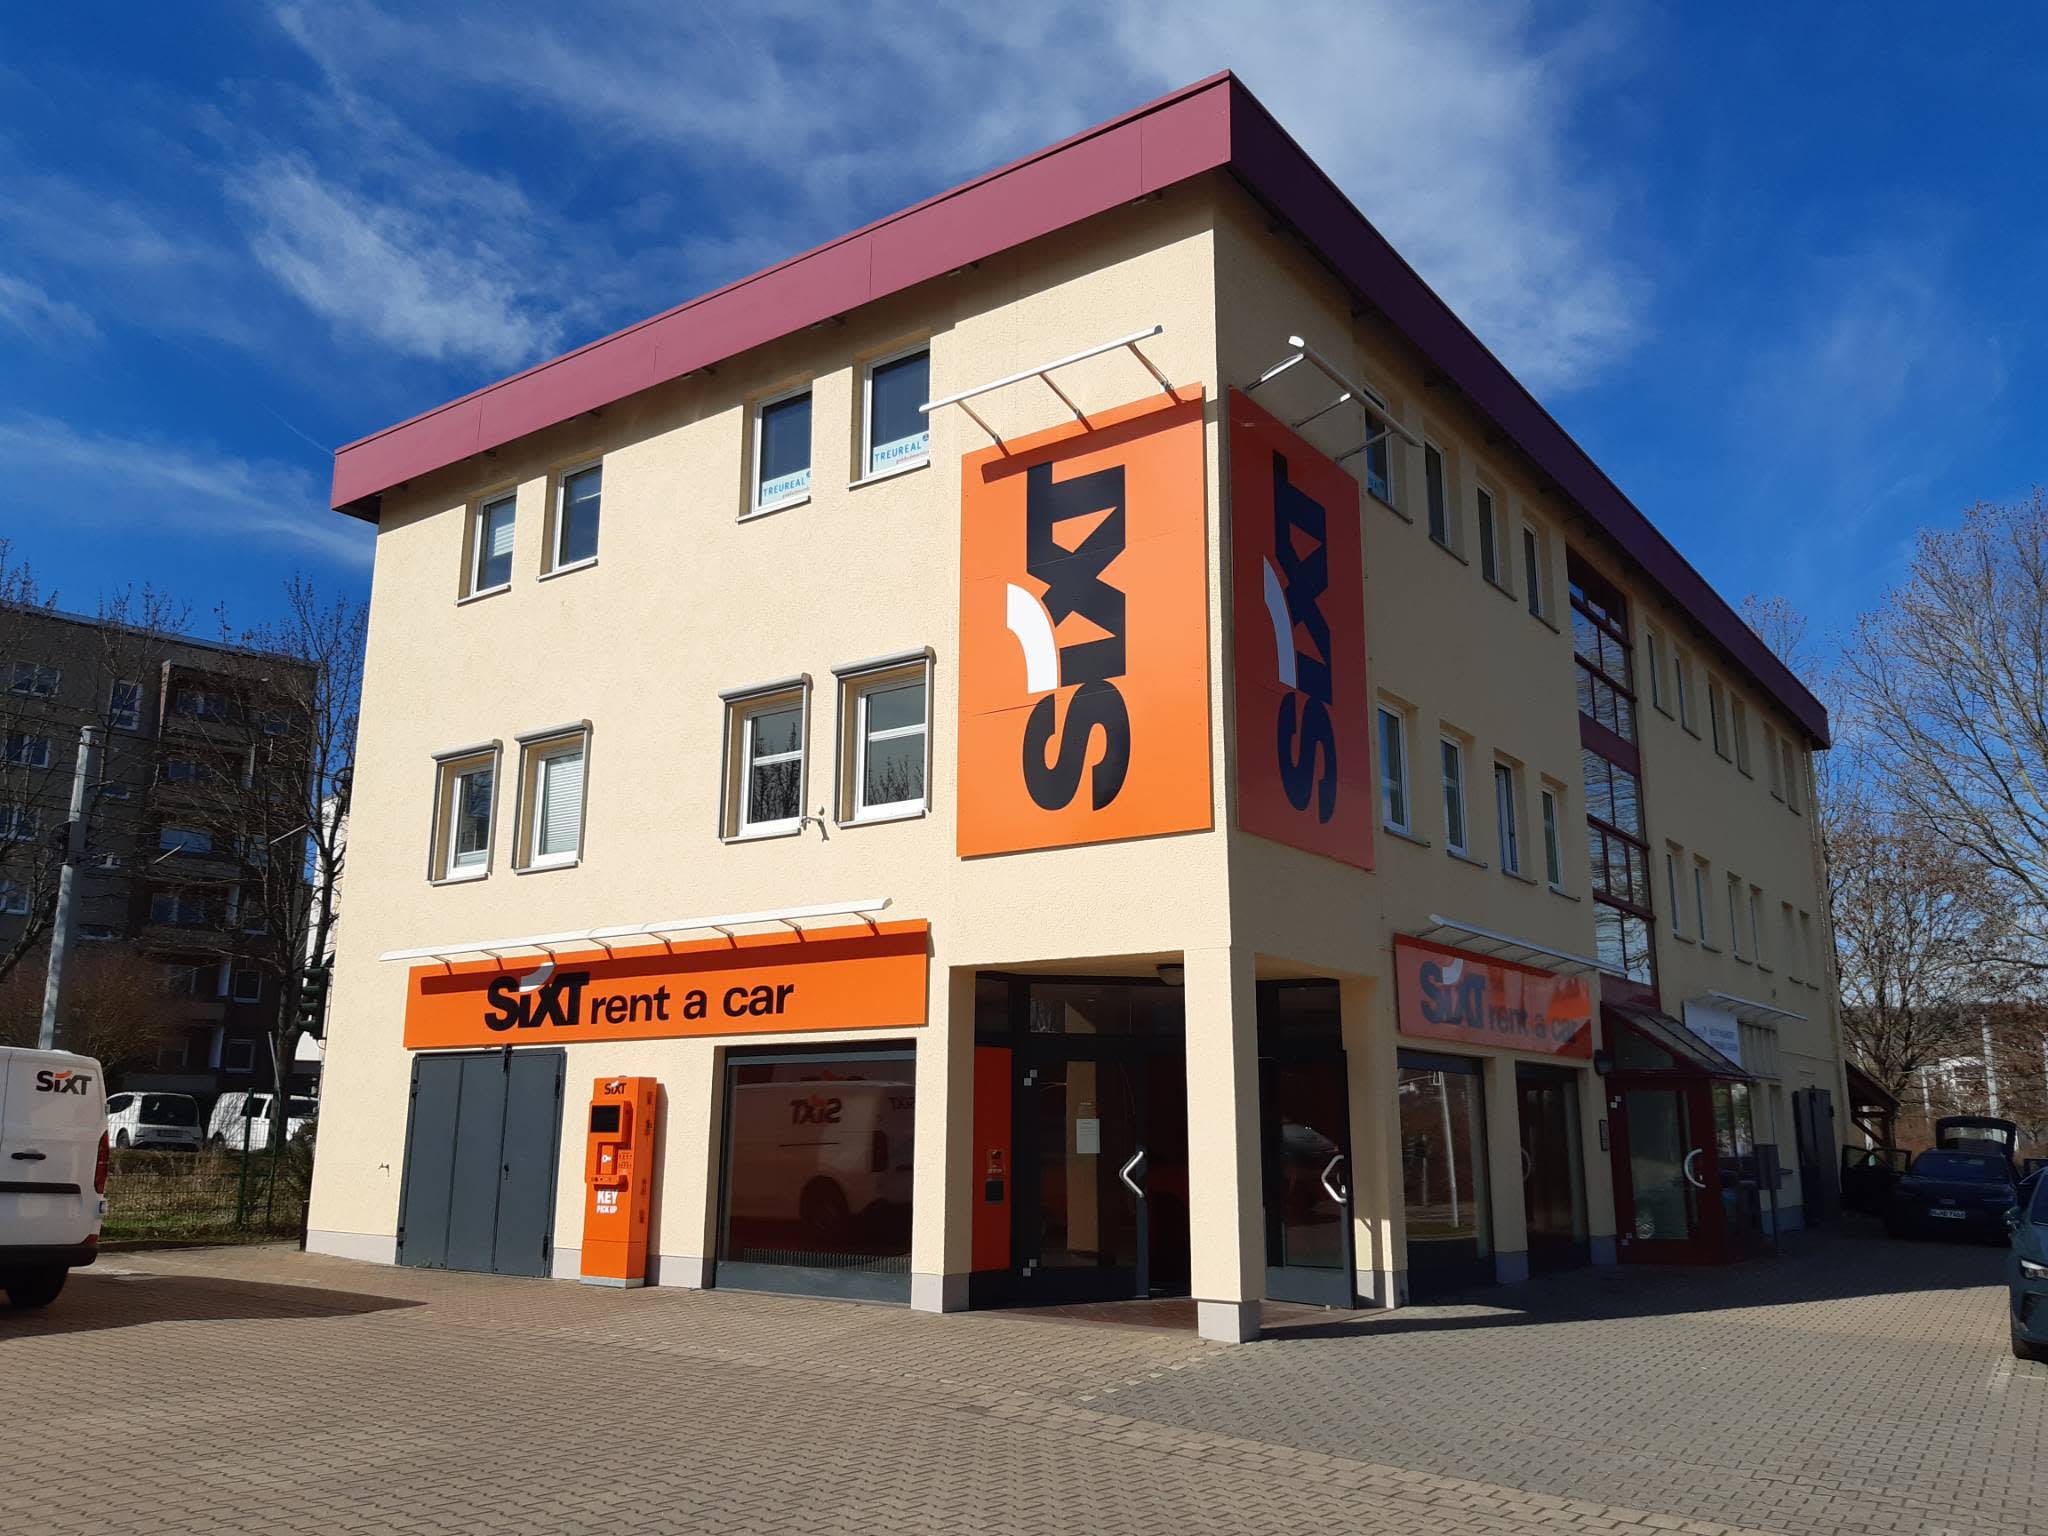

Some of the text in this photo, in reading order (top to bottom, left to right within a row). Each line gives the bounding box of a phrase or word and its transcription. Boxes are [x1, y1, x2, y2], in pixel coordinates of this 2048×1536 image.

[874, 440, 922, 463] TREUREAL
[763, 477, 805, 497] TREUREAL
[590, 984, 670, 1025] rent
[683, 989, 707, 1020] a
[723, 983, 794, 1017] car
[1489, 1005, 1529, 1036] rent
[1535, 1014, 1547, 1041] a
[597, 1190, 618, 1204] KEY
